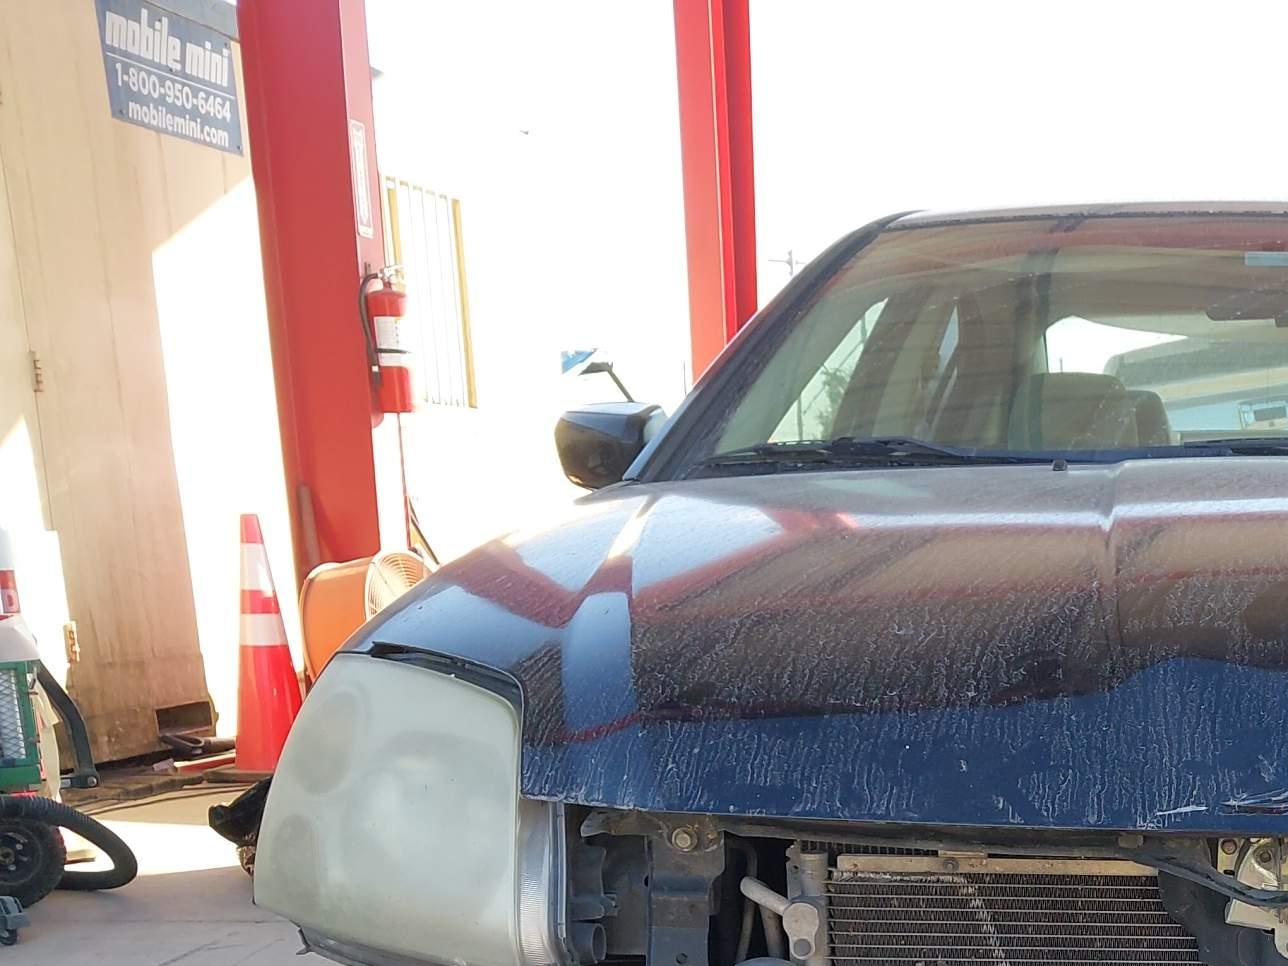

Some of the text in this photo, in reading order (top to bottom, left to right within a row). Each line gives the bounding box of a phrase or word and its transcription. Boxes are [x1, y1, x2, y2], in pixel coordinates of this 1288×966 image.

[105, 8, 229, 87] mobile mini
[115, 62, 232, 122] 1-800-950-6464
[128, 99, 229, 148] mobilemini.com
